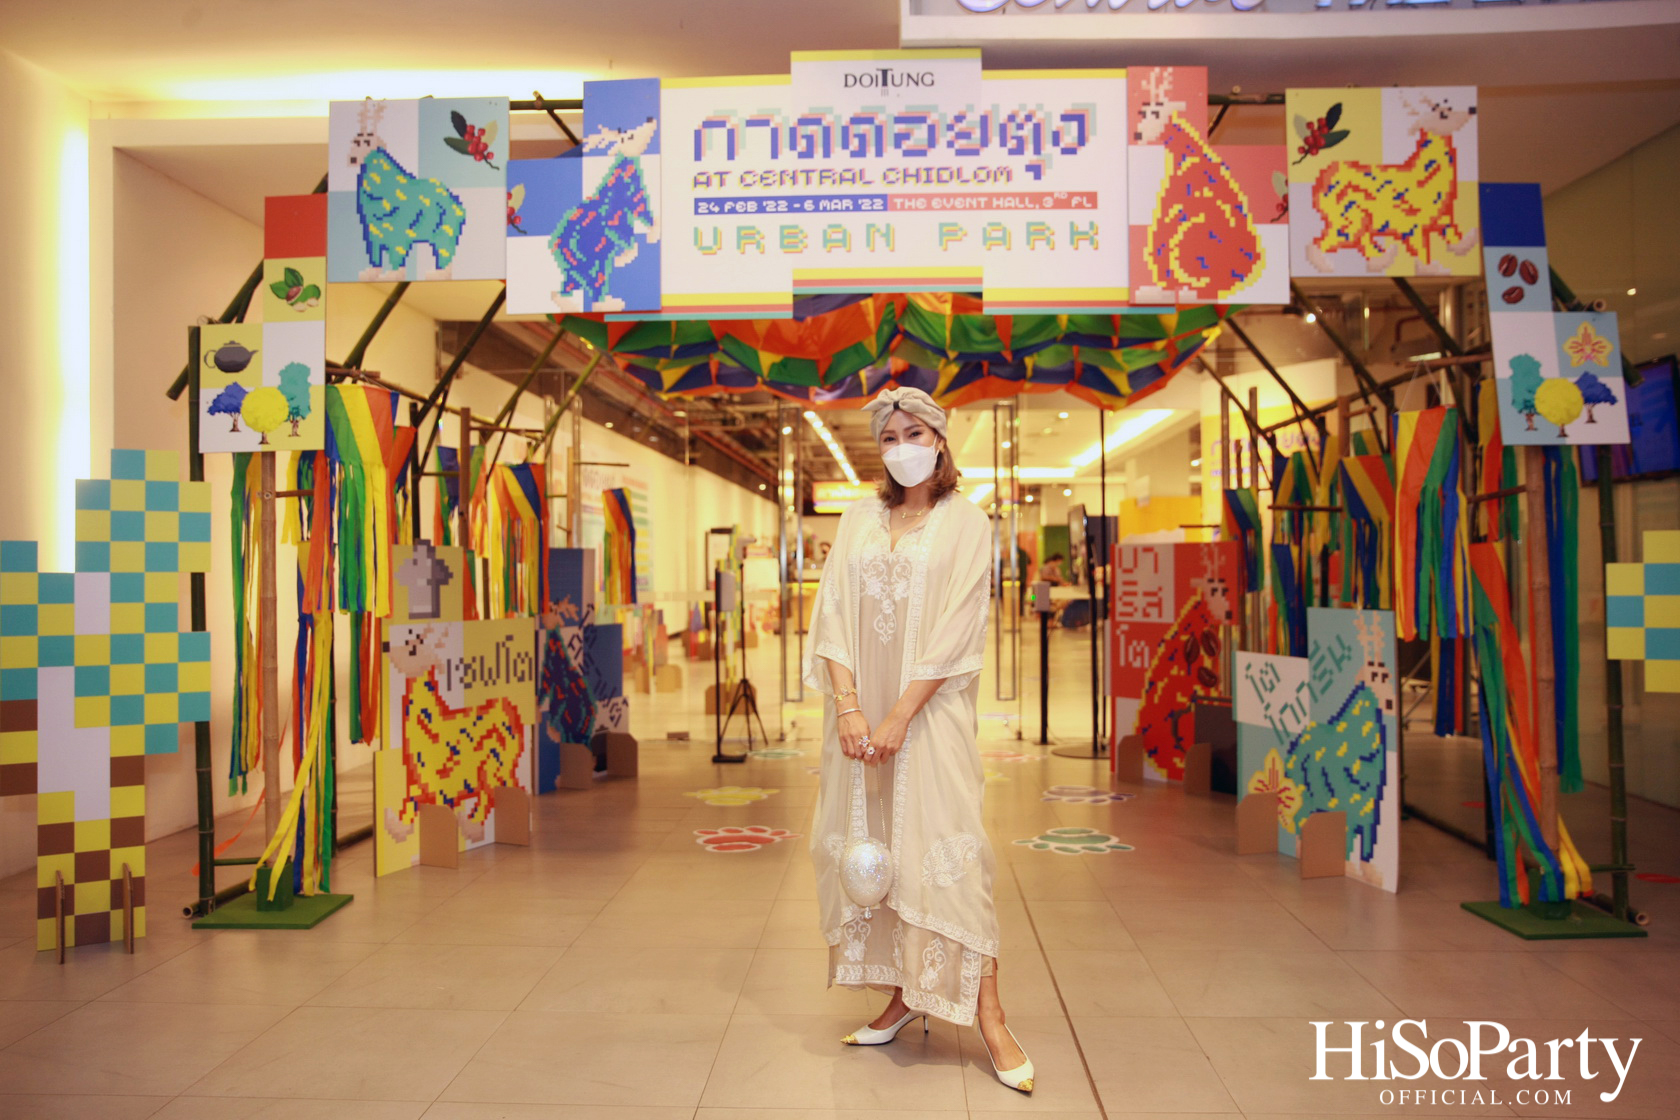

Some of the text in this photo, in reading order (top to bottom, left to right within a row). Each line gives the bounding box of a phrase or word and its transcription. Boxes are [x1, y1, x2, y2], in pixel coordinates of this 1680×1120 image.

[843, 68, 935, 88] DOITUNG
[693, 103, 1098, 181] กาดดอยตุง
[692, 166, 1013, 190] AT CENTRAL CHIDLOM
[697, 201, 720, 214] 24
[724, 200, 758, 213] FEB
[763, 200, 789, 212] '22
[803, 199, 815, 211] 6
[819, 198, 853, 211] MAR
[858, 198, 884, 210] '22
[893, 198, 927, 210] THE
[931, 197, 988, 209] EVENT
[992, 196, 1040, 209] HALL,
[1071, 196, 1092, 207] FL
[693, 221, 1099, 255] URBAN PARK
[1115, 623, 1149, 668] โต
